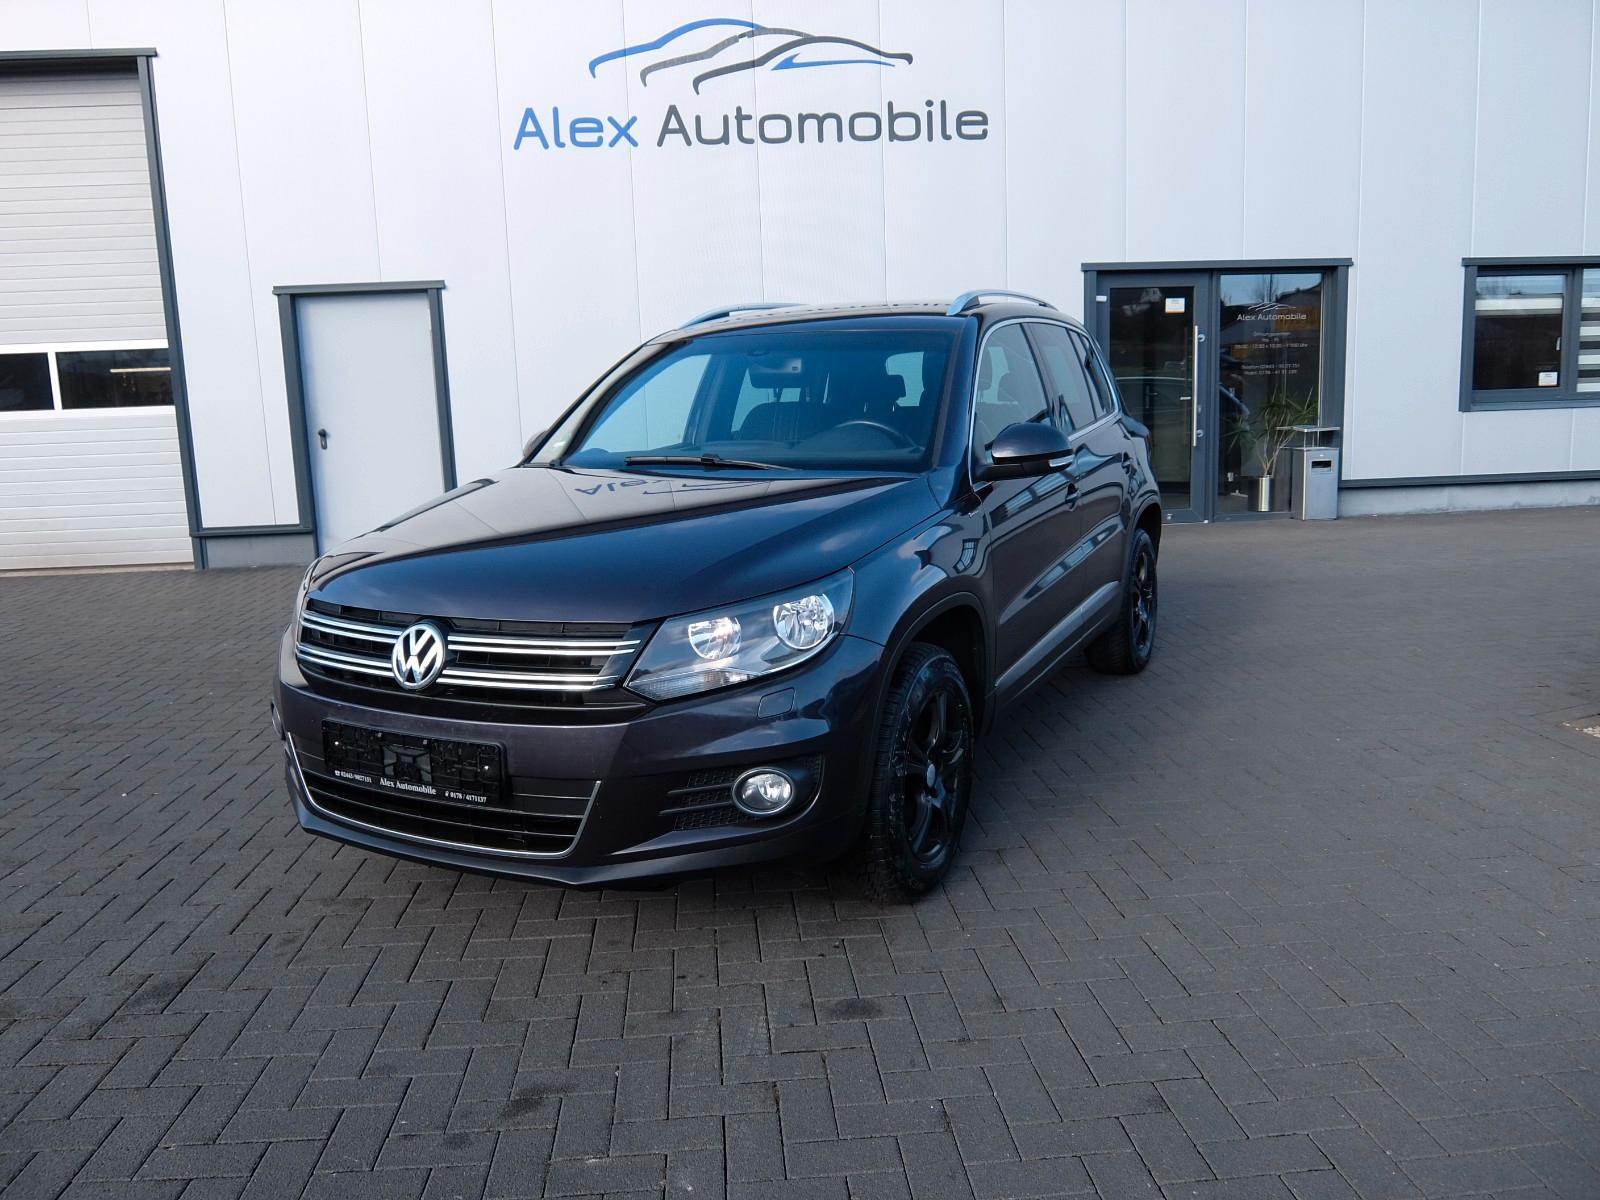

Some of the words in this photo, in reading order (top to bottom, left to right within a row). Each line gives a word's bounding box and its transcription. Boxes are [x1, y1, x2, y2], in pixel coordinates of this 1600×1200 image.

[513, 107, 638, 150] Alex
[657, 100, 989, 147] Automobile
[1237, 313, 1256, 321] Alex
[1258, 312, 1307, 321] Automobile
[393, 624, 443, 689] VW
[379, 777, 395, 788] Alex
[396, 780, 437, 795] Automobile
